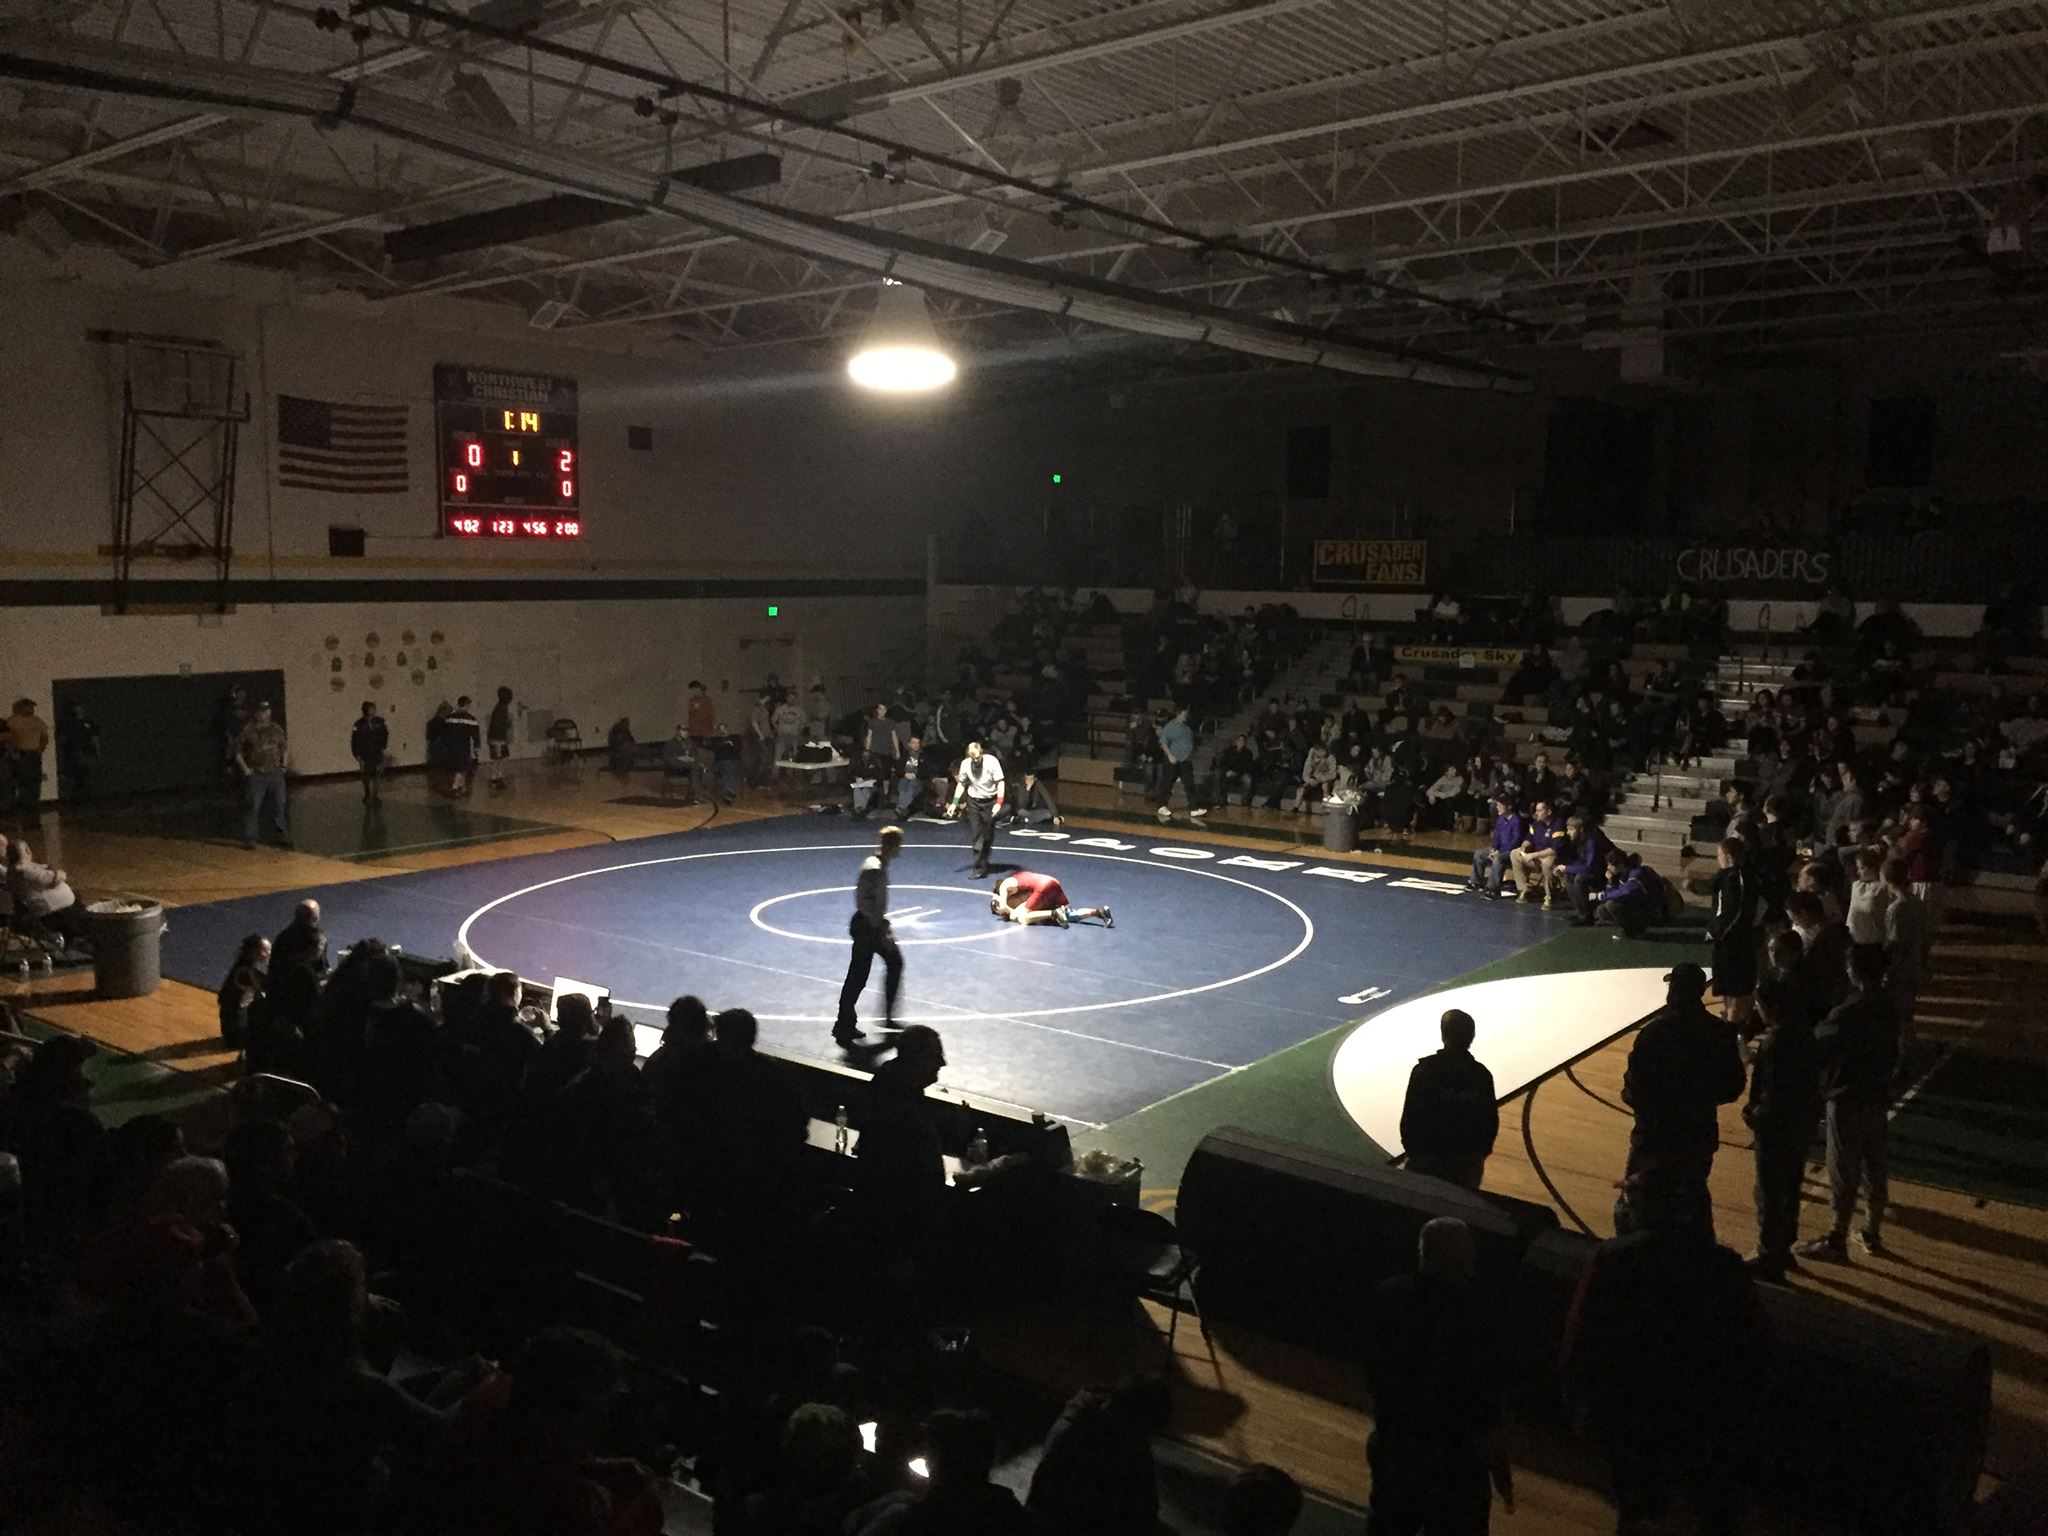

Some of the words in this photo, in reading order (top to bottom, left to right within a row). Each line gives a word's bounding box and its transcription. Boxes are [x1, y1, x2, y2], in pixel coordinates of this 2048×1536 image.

[467, 371, 554, 391] NORTHWEST
[472, 384, 548, 402] CHRISTIAN
[504, 410, 538, 432] 1:14
[468, 444, 481, 467] 0
[512, 450, 519, 466] 1
[560, 451, 572, 472] 2
[456, 474, 467, 492] 0
[562, 480, 572, 497] 0
[492, 520, 514, 534] 123
[523, 521, 547, 535] 456
[1318, 542, 1422, 567] CRUSADER
[1366, 562, 1419, 582] FANS
[1676, 548, 1831, 583] CRUSADERS
[1484, 649, 1517, 664] Sky
[1008, 828, 1517, 898] SPOKAN
